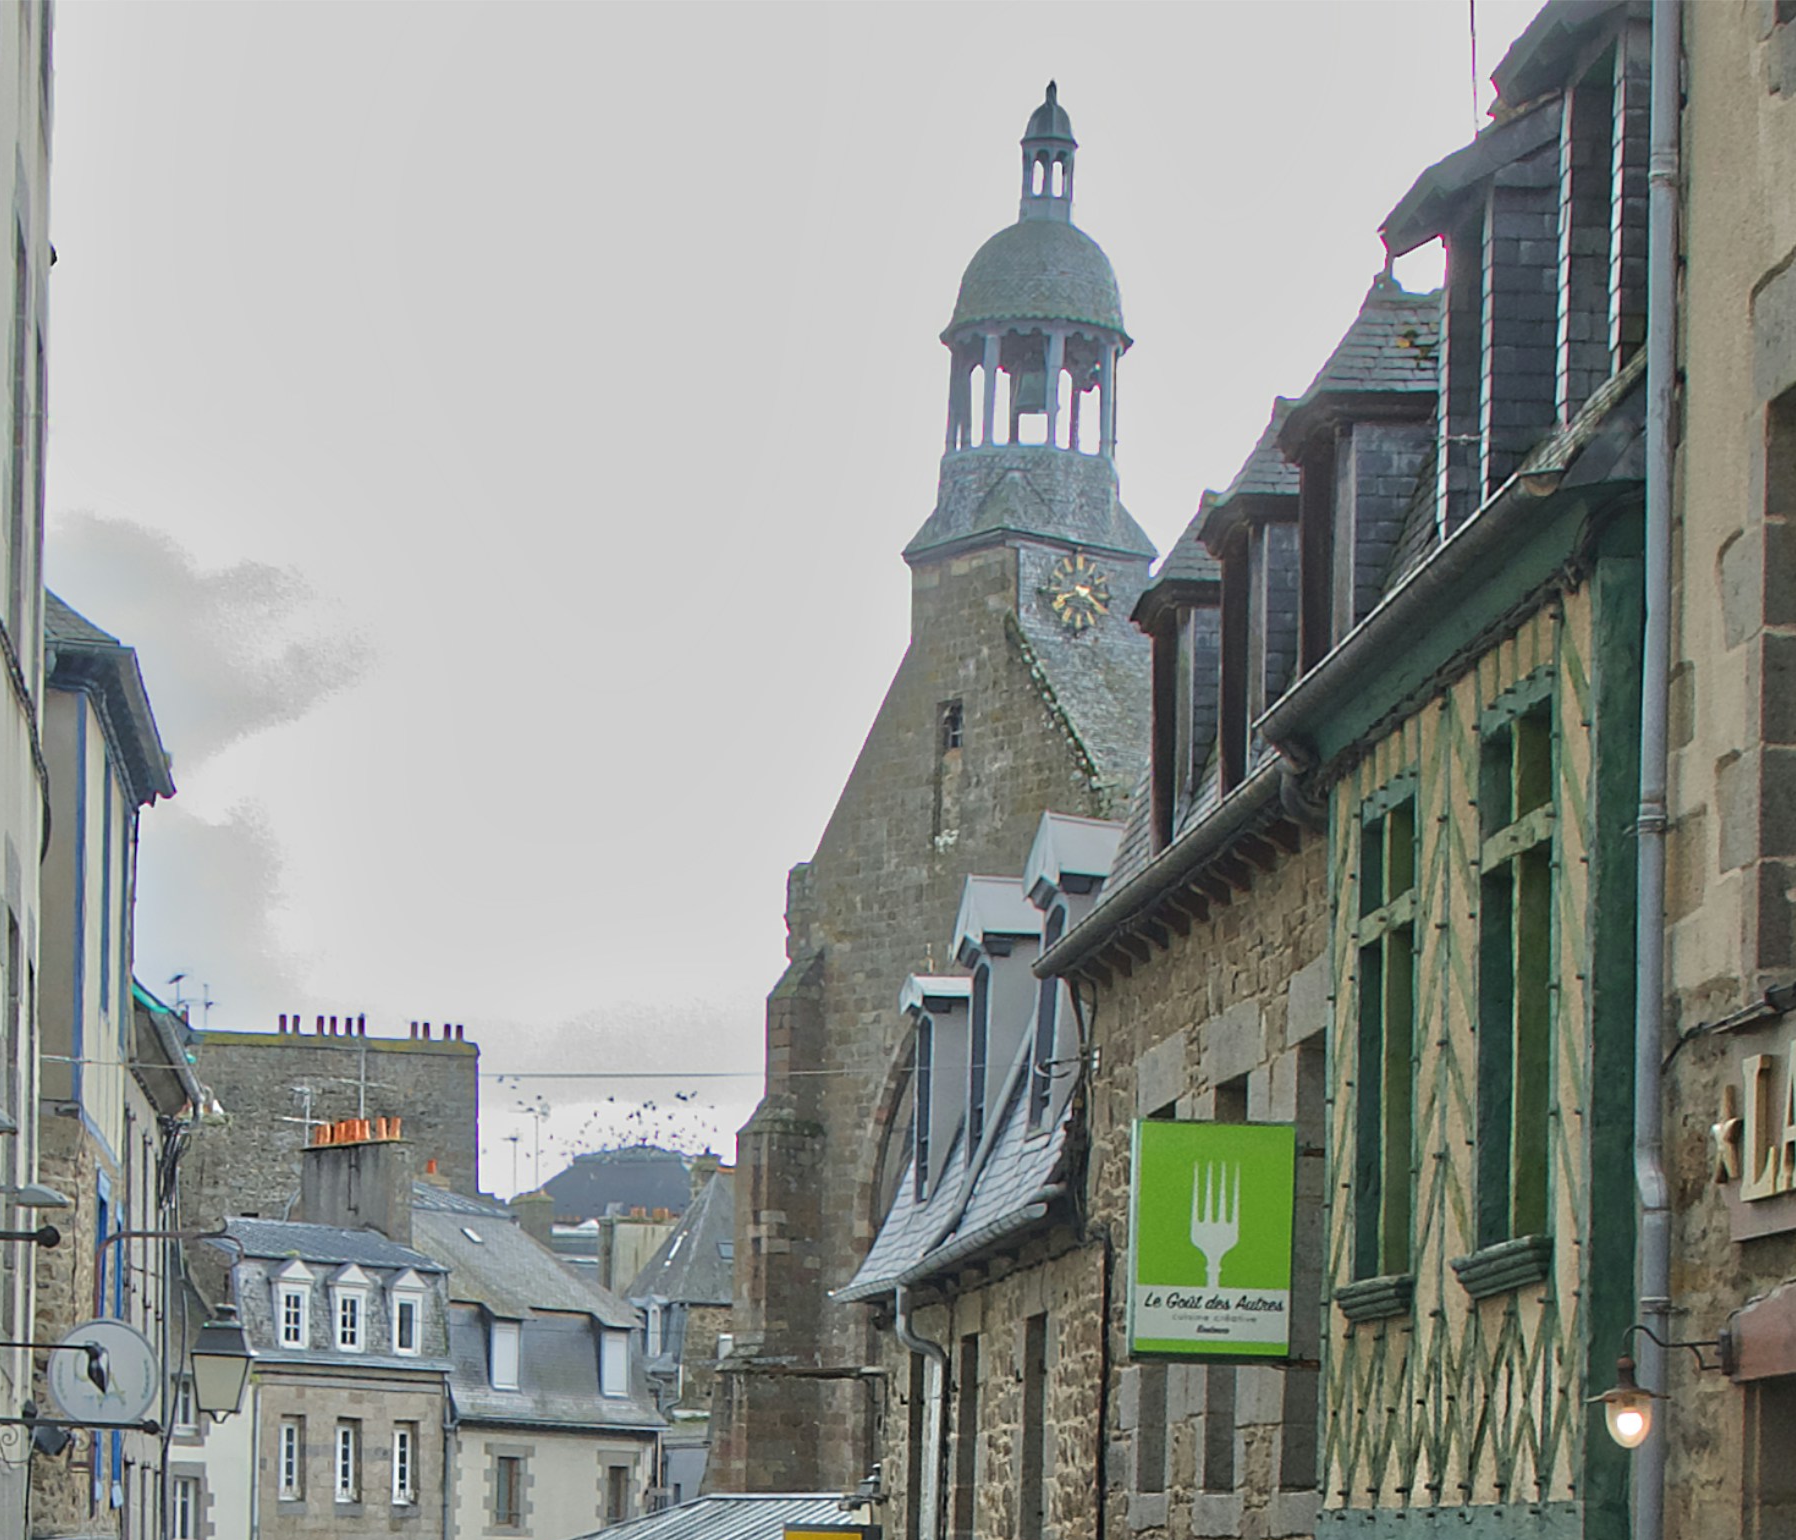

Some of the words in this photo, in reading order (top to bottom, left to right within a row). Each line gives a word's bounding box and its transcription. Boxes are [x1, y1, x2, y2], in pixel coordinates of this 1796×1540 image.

[1144, 1292, 1162, 1309] Le
[1166, 1292, 1203, 1309] Goût
[1205, 1294, 1231, 1311] des
[1235, 1295, 1285, 1312] Autres
